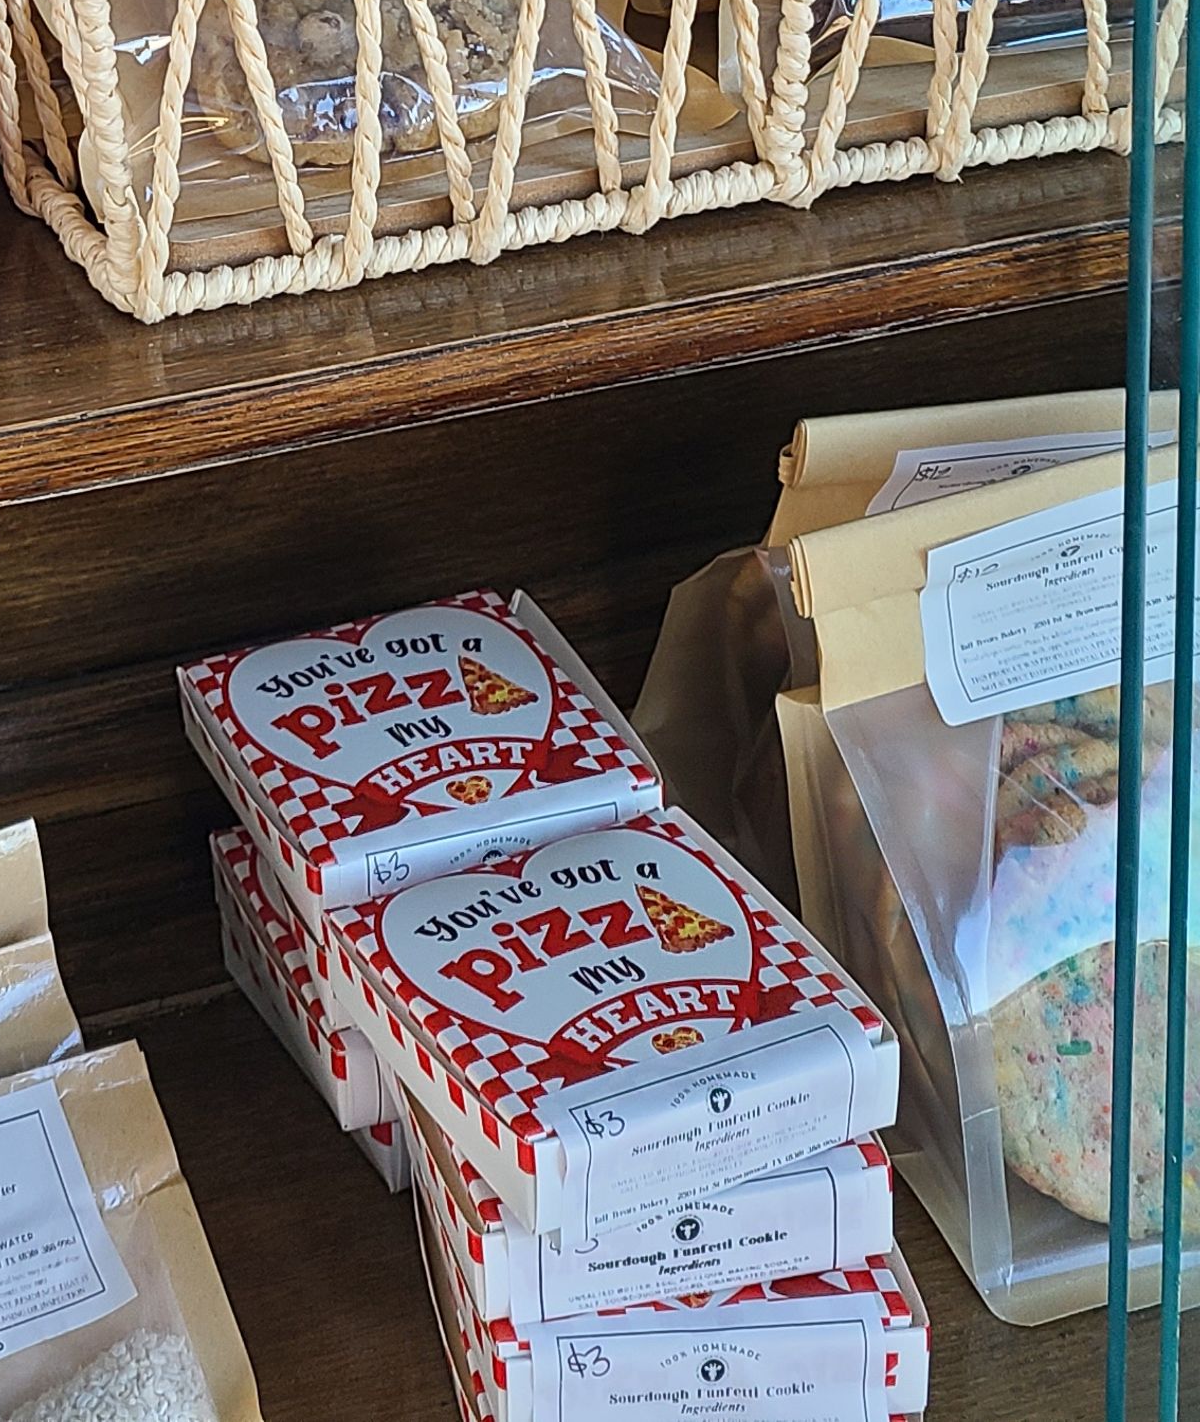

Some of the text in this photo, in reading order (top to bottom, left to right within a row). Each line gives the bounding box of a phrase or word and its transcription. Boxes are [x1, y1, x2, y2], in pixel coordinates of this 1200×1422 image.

[985, 565, 1050, 592] Sourdough
[1043, 567, 1096, 589] Ingredients
[385, 633, 448, 657] got
[462, 637, 484, 653] a
[270, 668, 466, 760] pizz
[385, 715, 453, 748] my
[369, 741, 533, 797] HEART
[372, 851, 411, 886] $3
[550, 859, 622, 889] got
[636, 861, 662, 881] a
[437, 899, 655, 1013] pizz
[568, 955, 646, 996] my
[563, 983, 740, 1054] HEART
[692, 1069, 758, 1088] HOMEMADE
[584, 1109, 626, 1140] $3
[631, 1127, 702, 1156] Sourdough
[766, 1091, 811, 1113] Cookie
[695, 1127, 751, 1153] Ingredients
[588, 1251, 667, 1273] Sourdough
[739, 1229, 789, 1247] Cookie
[658, 1257, 721, 1276] Ingredients
[567, 1342, 611, 1379] $3
[692, 1343, 762, 1361] HOMEMADE
[609, 1388, 690, 1406] Sourdough
[765, 1381, 816, 1398] Cookie
[680, 1402, 747, 1416] Ingredients
